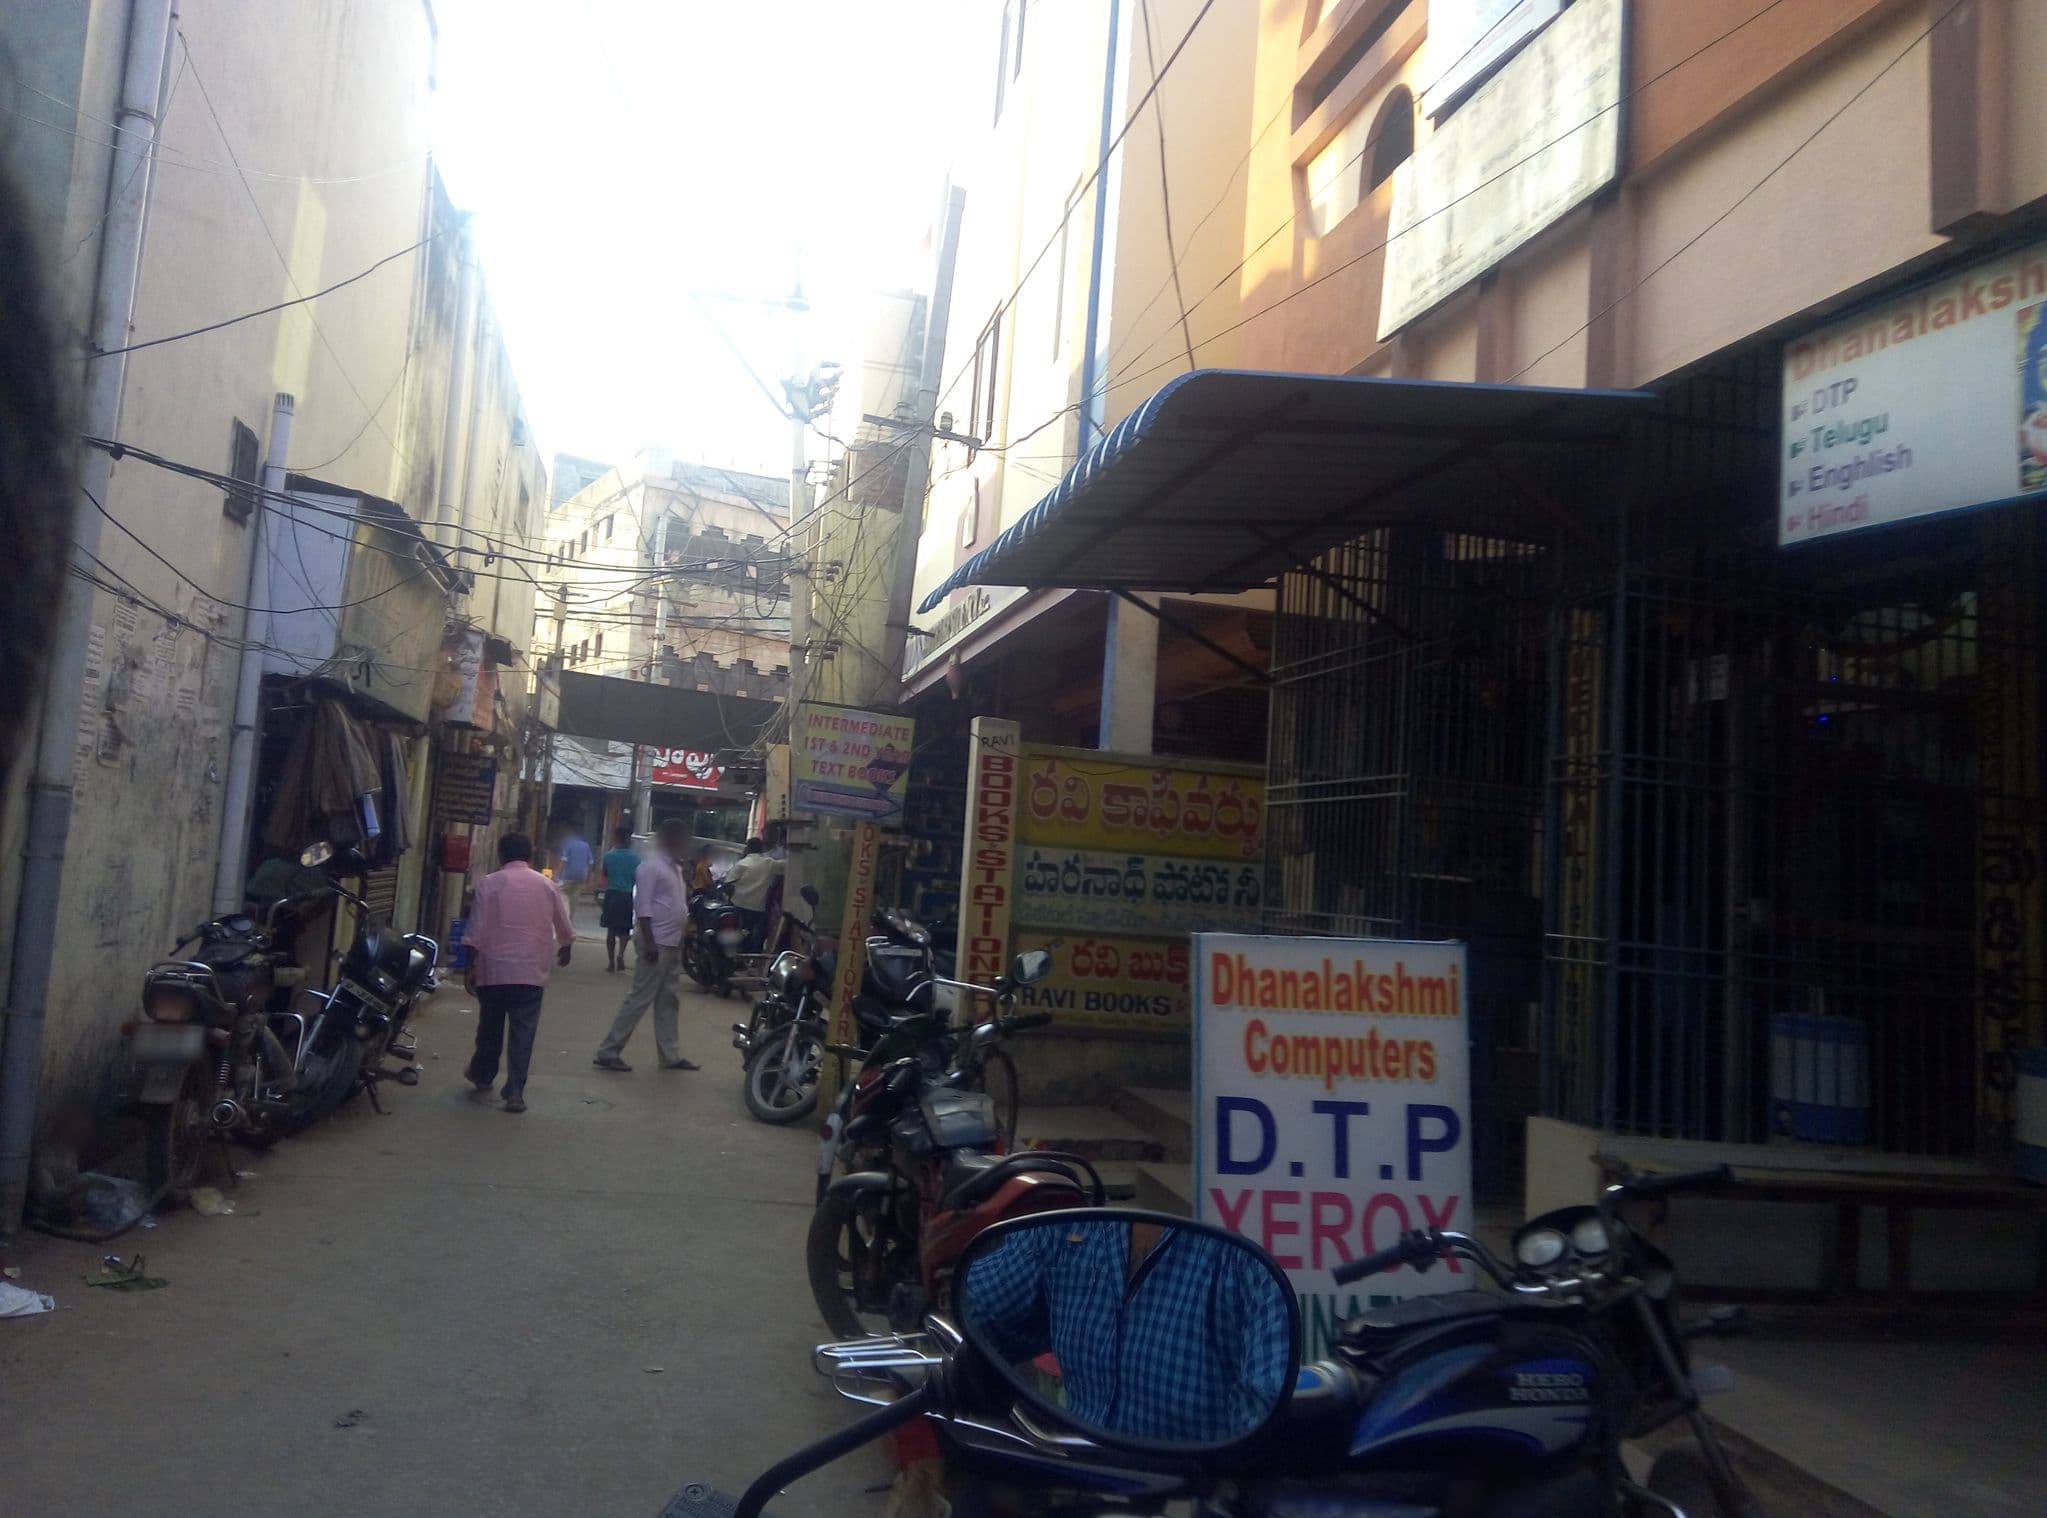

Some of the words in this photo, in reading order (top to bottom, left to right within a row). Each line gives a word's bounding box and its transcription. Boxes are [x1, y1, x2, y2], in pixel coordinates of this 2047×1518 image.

[1812, 377, 1858, 414] DTP
[1810, 412, 1890, 454] Telugu
[1807, 493, 1869, 531] Hindi
[807, 712, 911, 742] INTERMEDIATE
[980, 735, 1014, 748] RAVI
[803, 735, 826, 751] 1ST
[843, 740, 871, 758] 2ND
[811, 759, 843, 778] TEXT
[847, 765, 898, 785] BOOKS
[977, 754, 1014, 843] BOOKS
[1030, 759, 1090, 824] రవి
[1071, 939, 1120, 979] రవి
[1022, 987, 1076, 1009] RAVI
[1084, 991, 1172, 1017] BOOKS
[1210, 950, 1461, 1017] Dhanalakshmi
[1244, 1018, 1438, 1089] Computers
[1515, 1372, 1584, 1387] HERO
